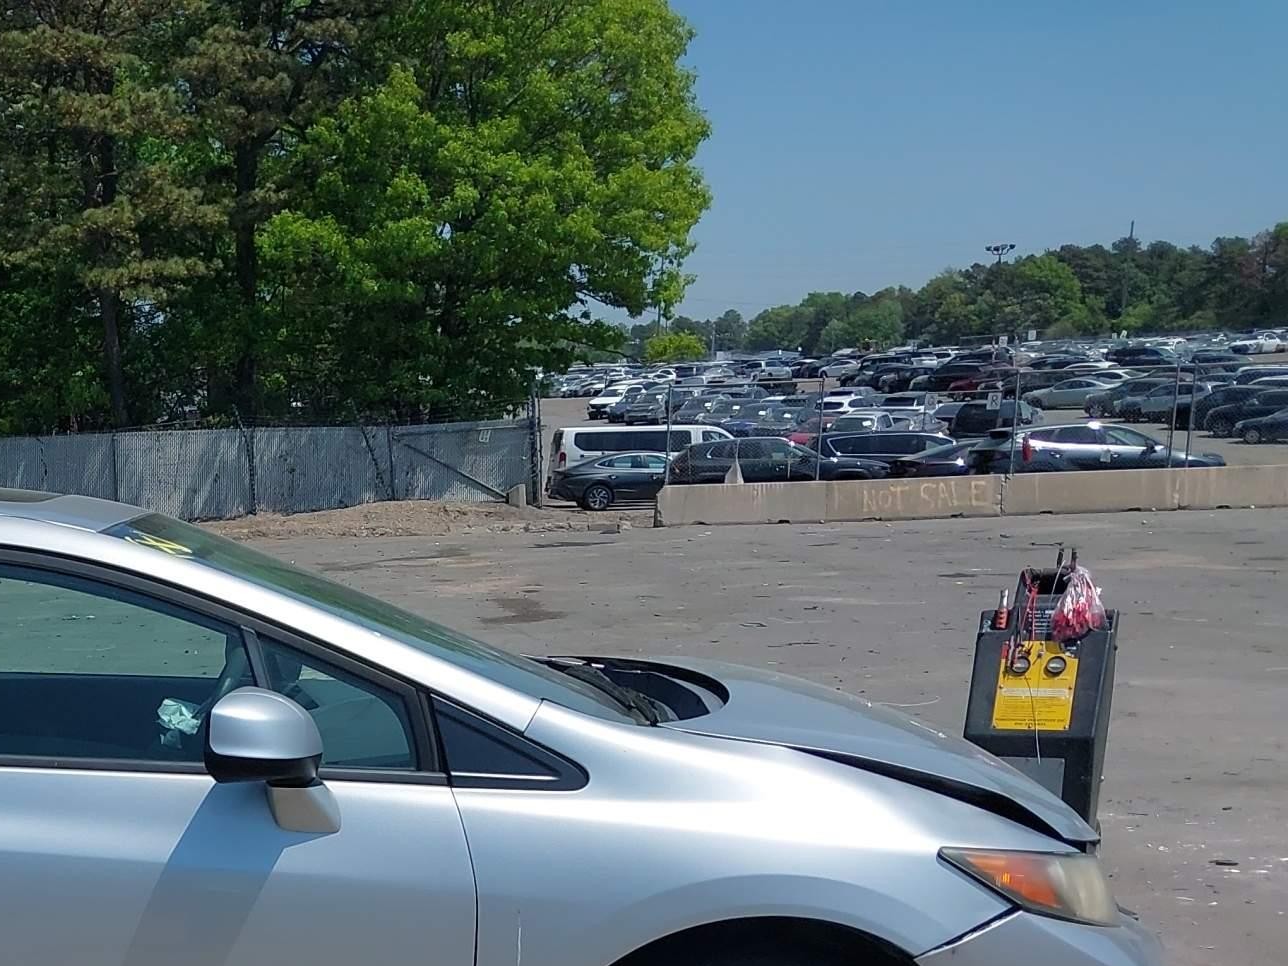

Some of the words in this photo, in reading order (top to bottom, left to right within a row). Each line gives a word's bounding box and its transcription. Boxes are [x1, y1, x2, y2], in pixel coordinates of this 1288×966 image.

[990, 394, 1000, 408] R
[863, 483, 909, 512] NOT
[920, 480, 987, 513] SALE
